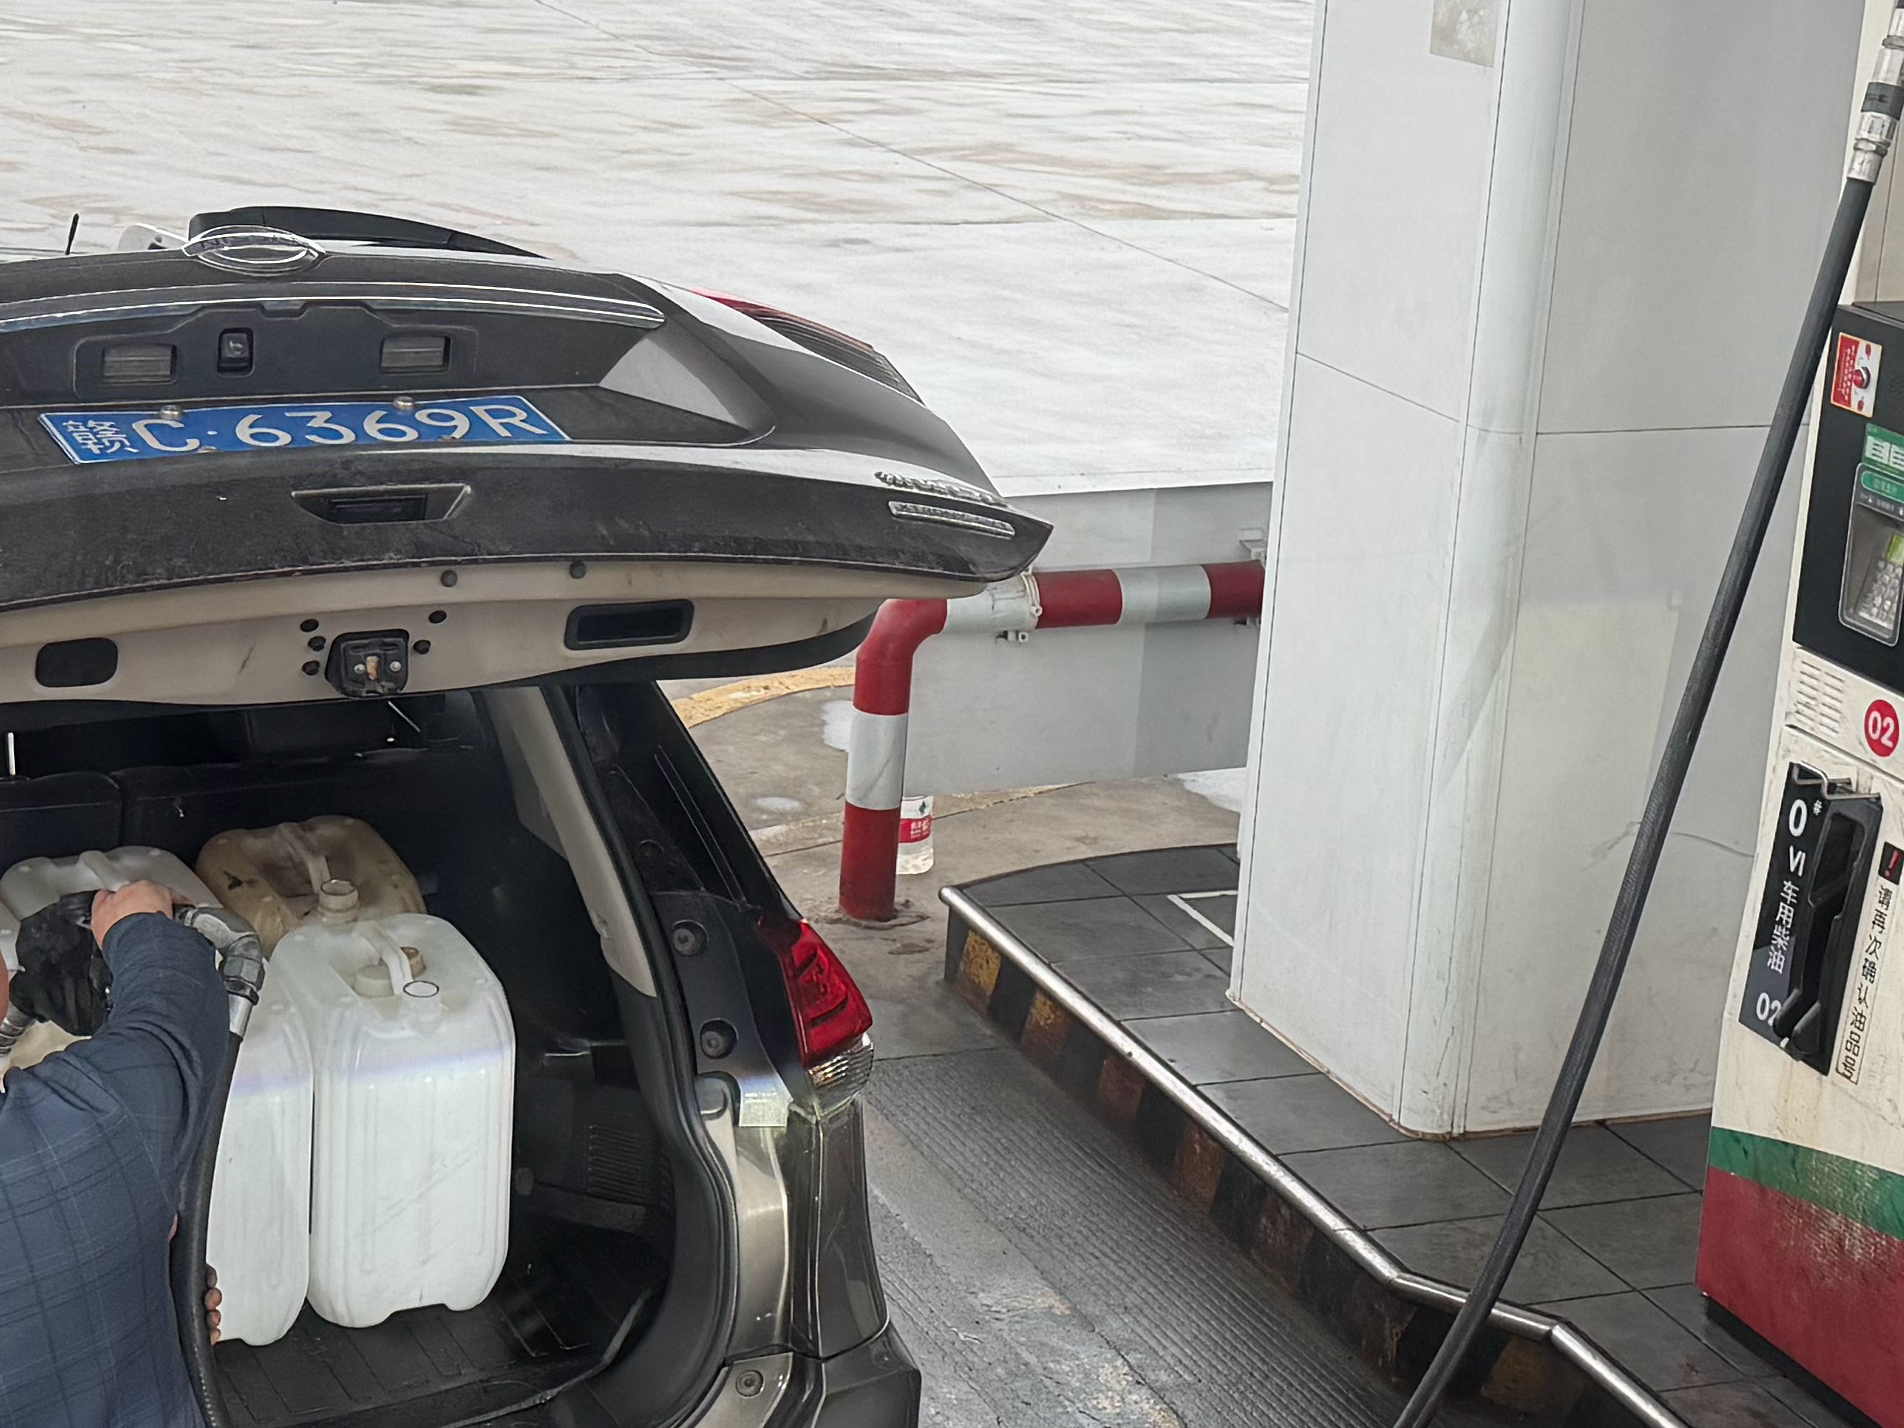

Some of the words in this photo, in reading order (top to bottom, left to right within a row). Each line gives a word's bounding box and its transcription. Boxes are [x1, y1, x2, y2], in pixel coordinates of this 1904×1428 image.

[1867, 709, 1895, 748] 02
[1767, 879, 1799, 974] 车用柴油
[1836, 884, 1894, 1089] 请再次确认油品号
